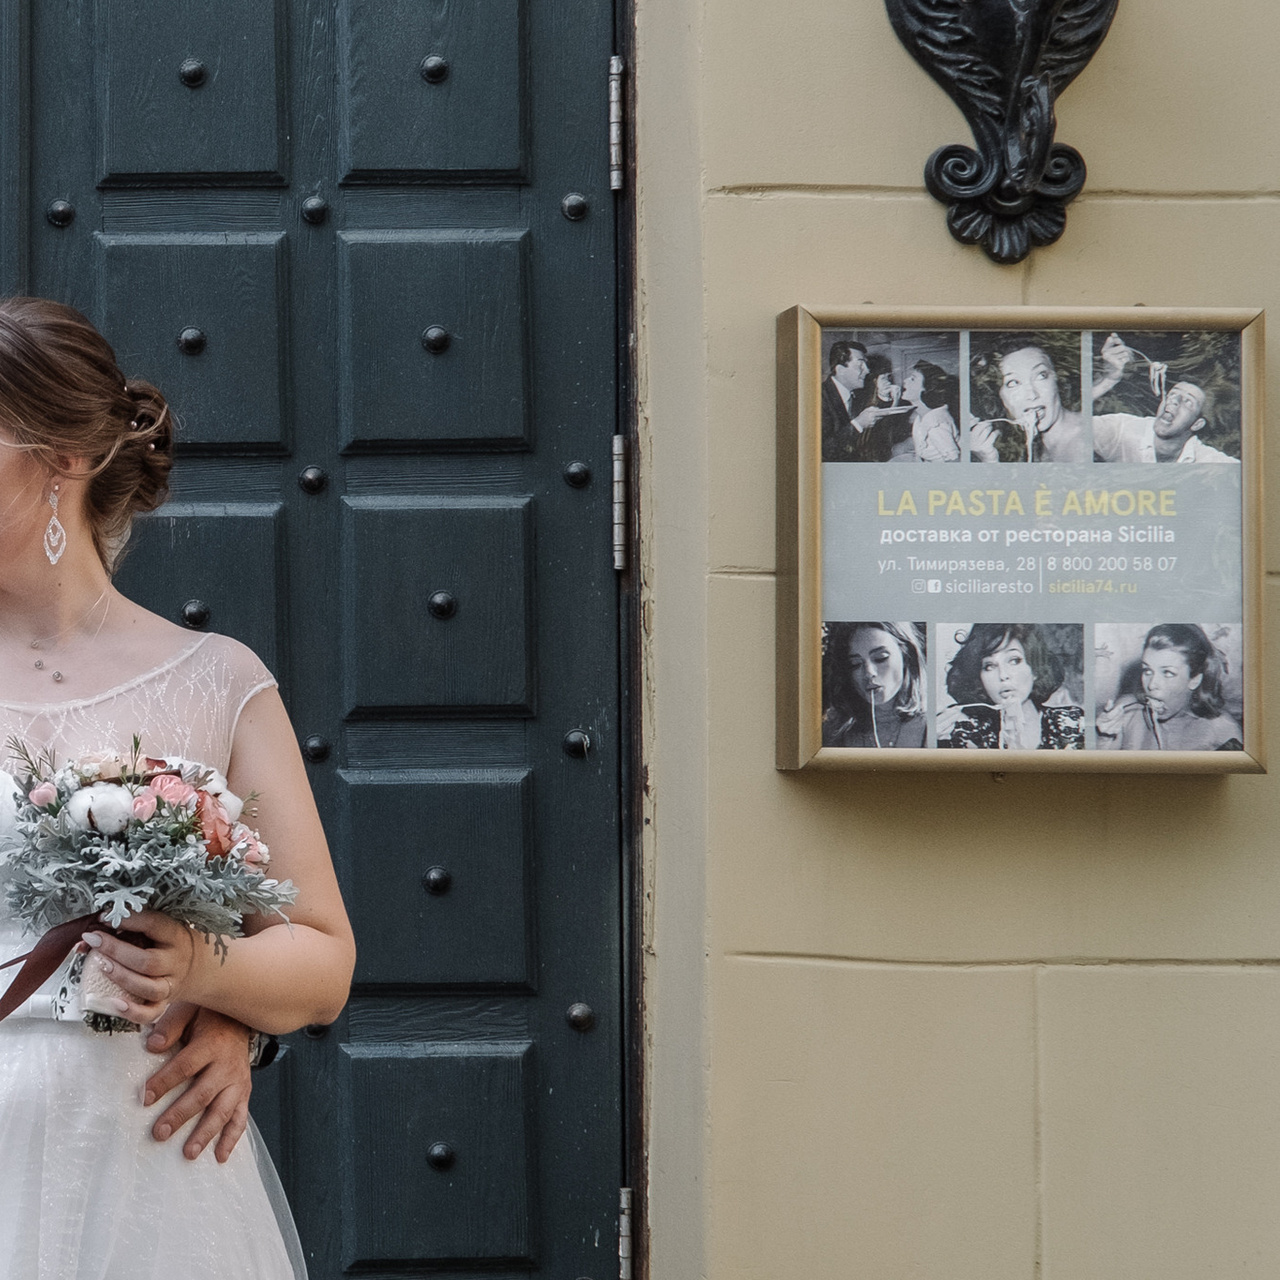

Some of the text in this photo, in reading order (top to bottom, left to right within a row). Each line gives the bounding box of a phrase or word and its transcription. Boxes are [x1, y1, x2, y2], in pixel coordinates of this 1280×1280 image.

[878, 484, 1176, 516] LA PASTA È AMORE
[880, 526, 1175, 546] доставка от ресторана Sicilia
[878, 557, 1036, 574] ул. Тимирязева, 28
[1047, 557, 1177, 571] 8 800 200 58 07
[946, 580, 1034, 594] siciliaresto
[1048, 580, 1137, 594] sicilia74.ru
